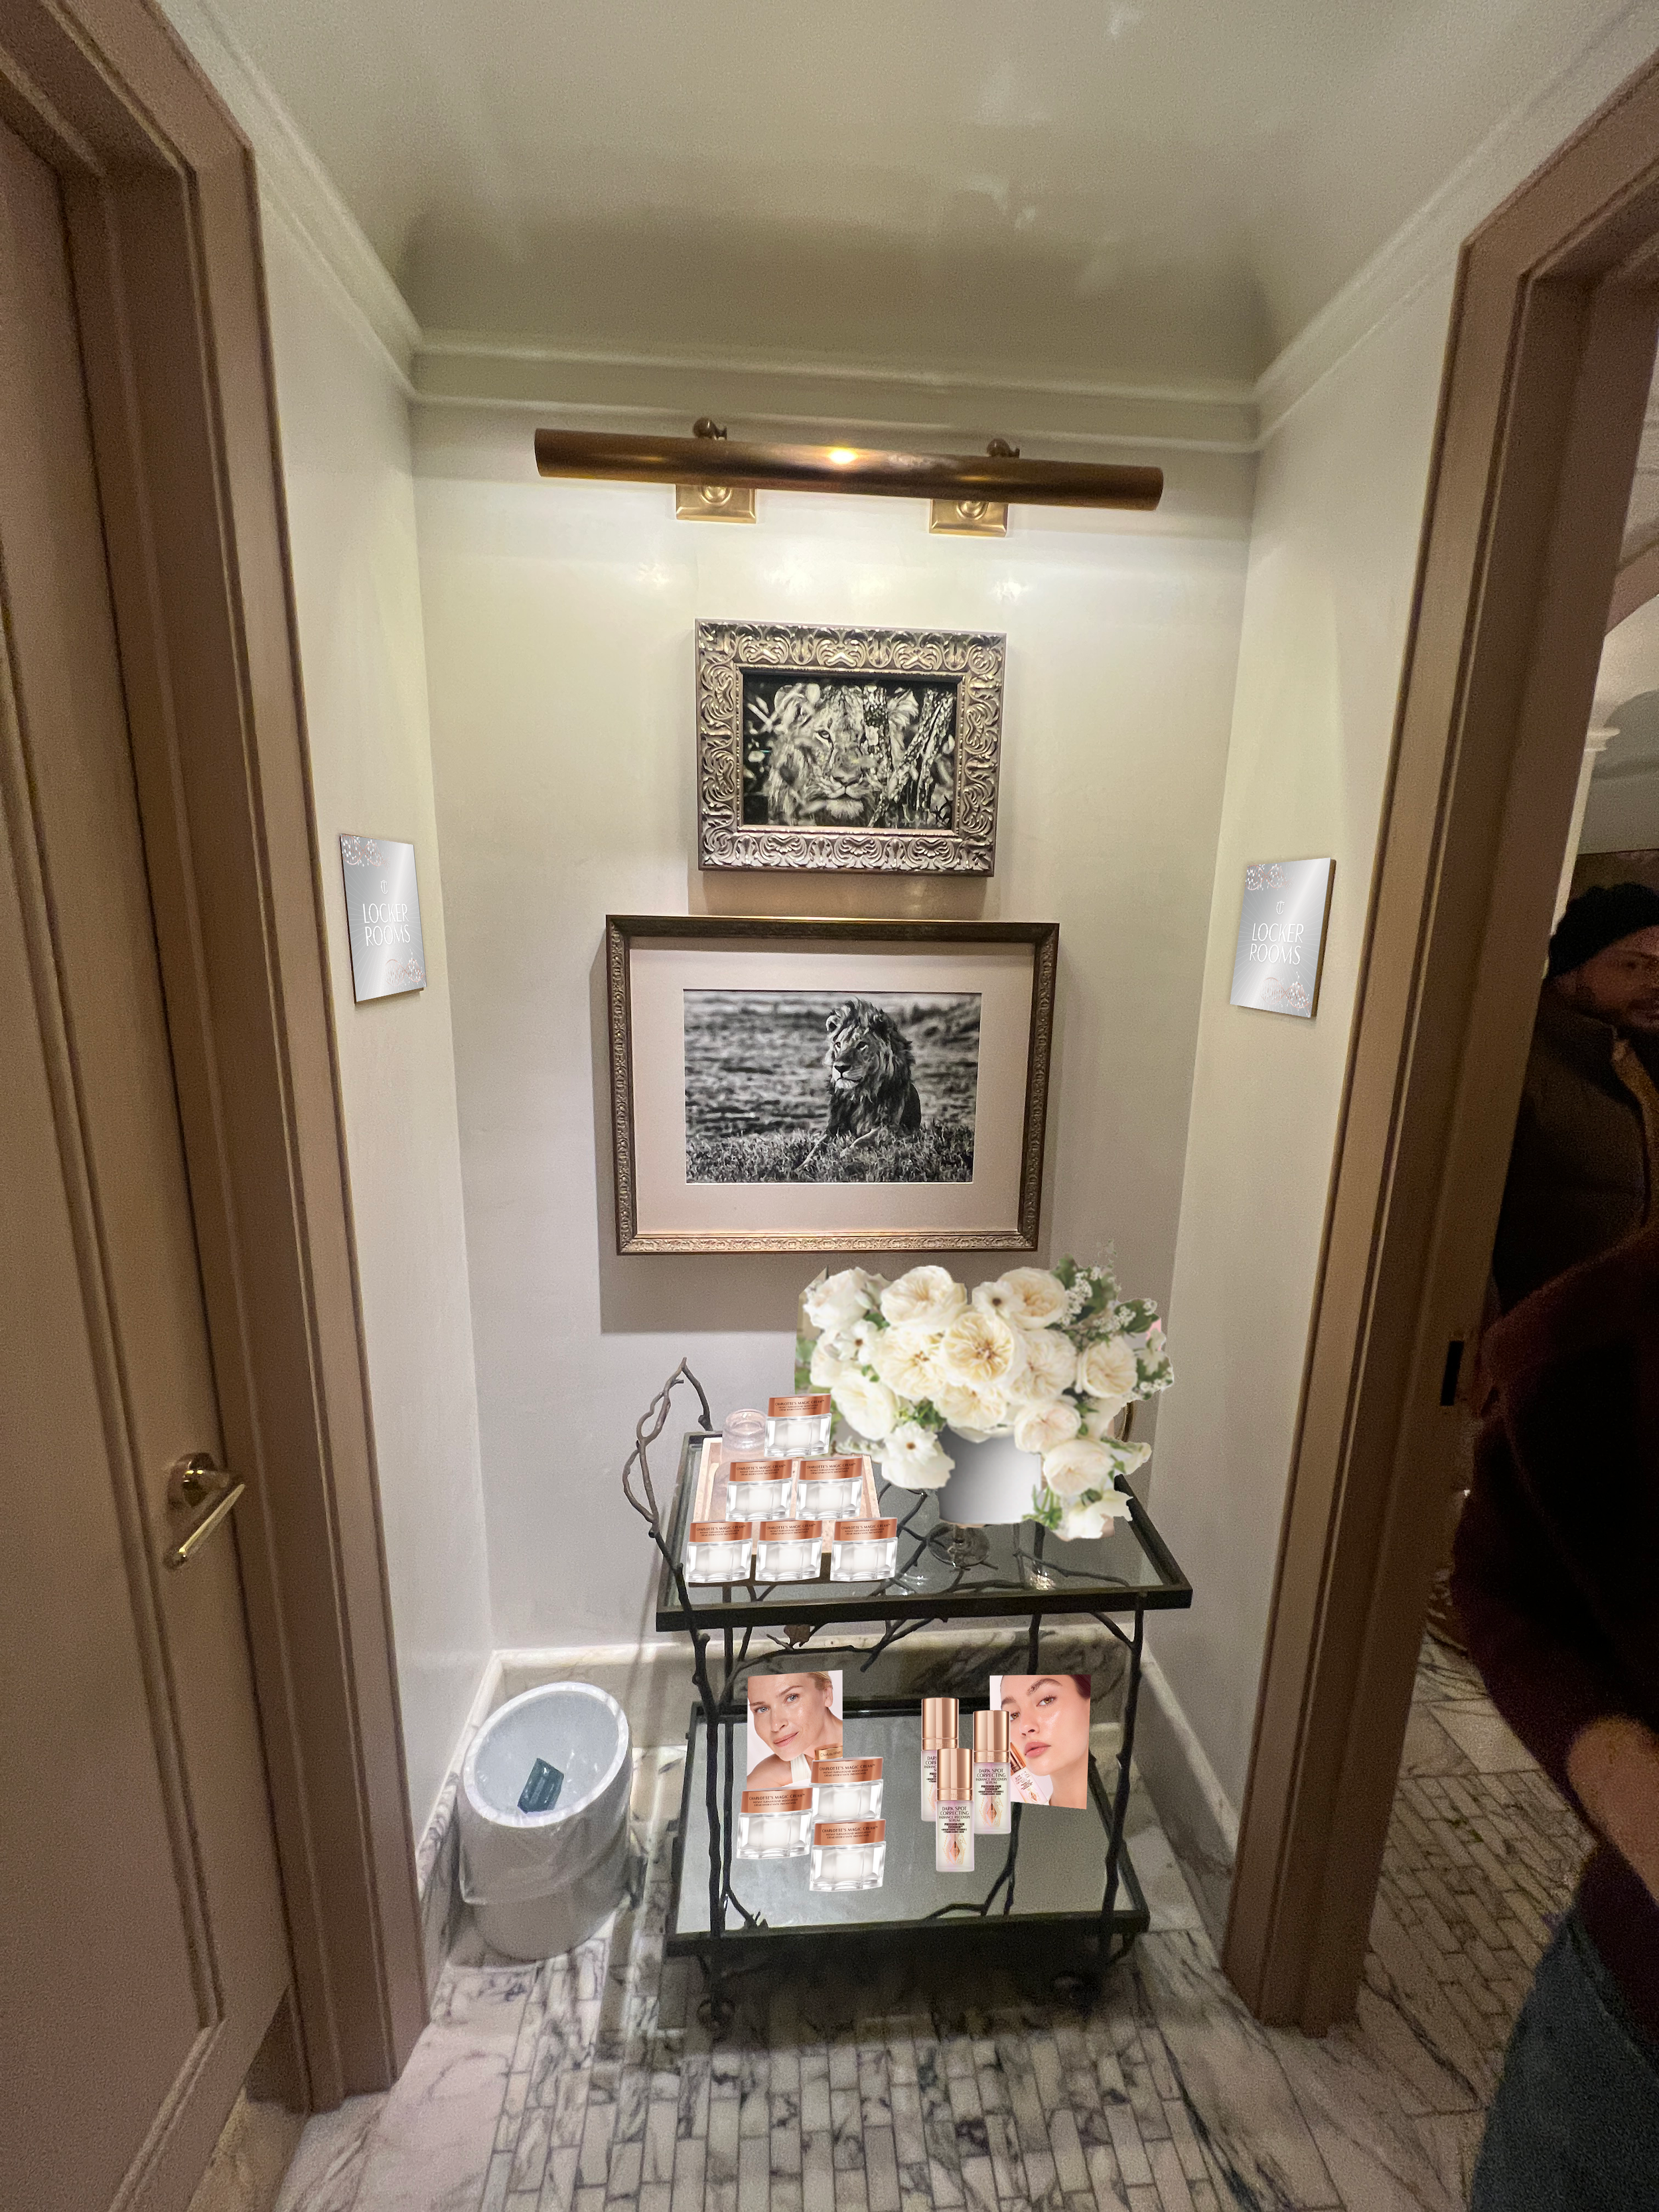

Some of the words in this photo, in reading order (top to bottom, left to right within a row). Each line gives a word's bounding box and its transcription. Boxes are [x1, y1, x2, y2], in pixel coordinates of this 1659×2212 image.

[362, 903, 409, 924] LOCKER
[365, 924, 411, 946] ROOMS
[1252, 922, 1304, 943] LOCKER
[1249, 944, 1301, 965] ROOMS
